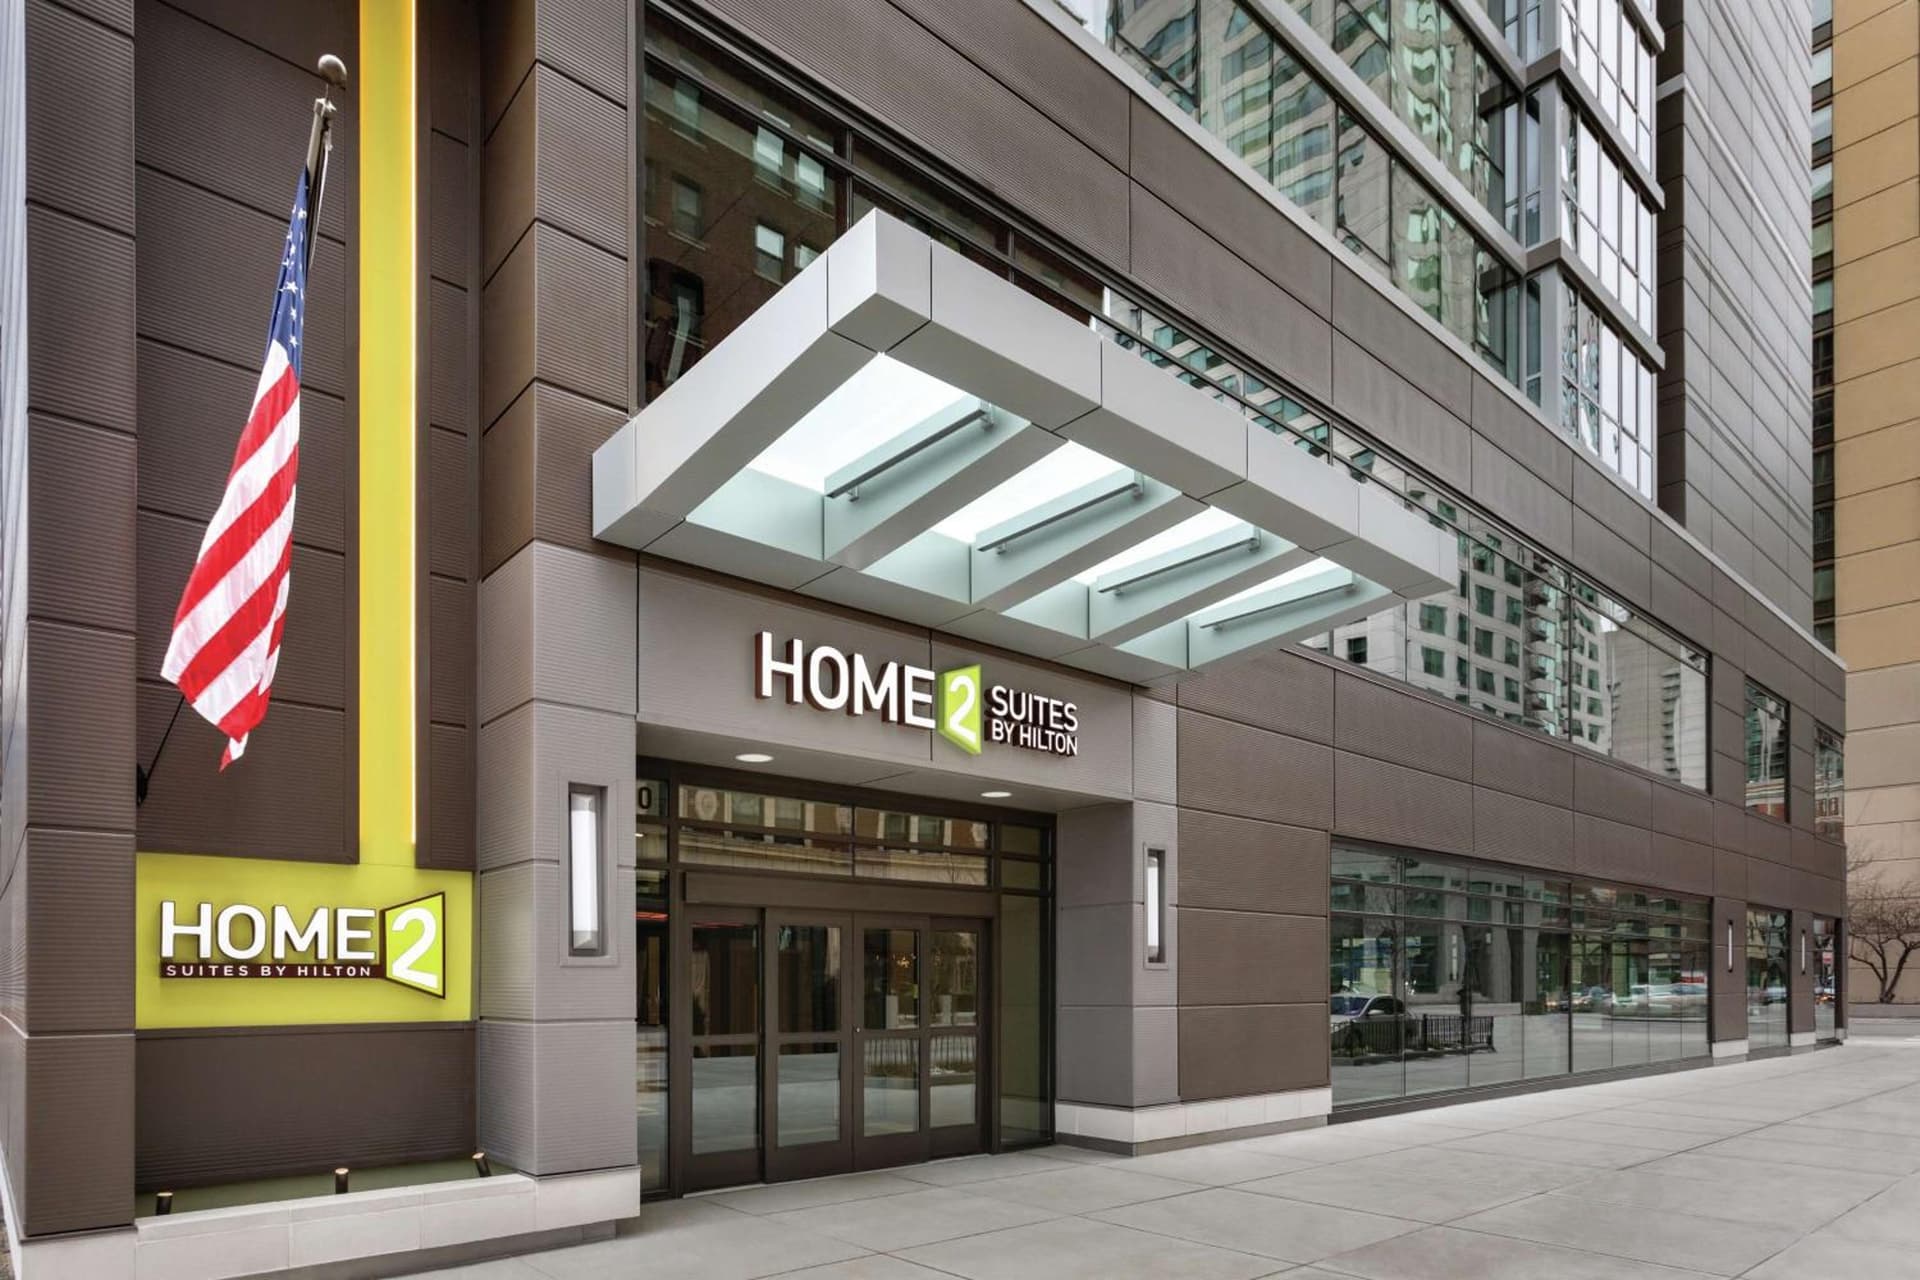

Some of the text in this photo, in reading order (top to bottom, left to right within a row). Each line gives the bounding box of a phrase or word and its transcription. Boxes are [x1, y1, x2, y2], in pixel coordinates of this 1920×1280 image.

[760, 631, 935, 729] HOME
[991, 685, 1078, 732] SUITES
[991, 718, 1078, 756] BY HILTON
[161, 901, 376, 960] HOME
[166, 965, 371, 977] SUITES BY HILTON
